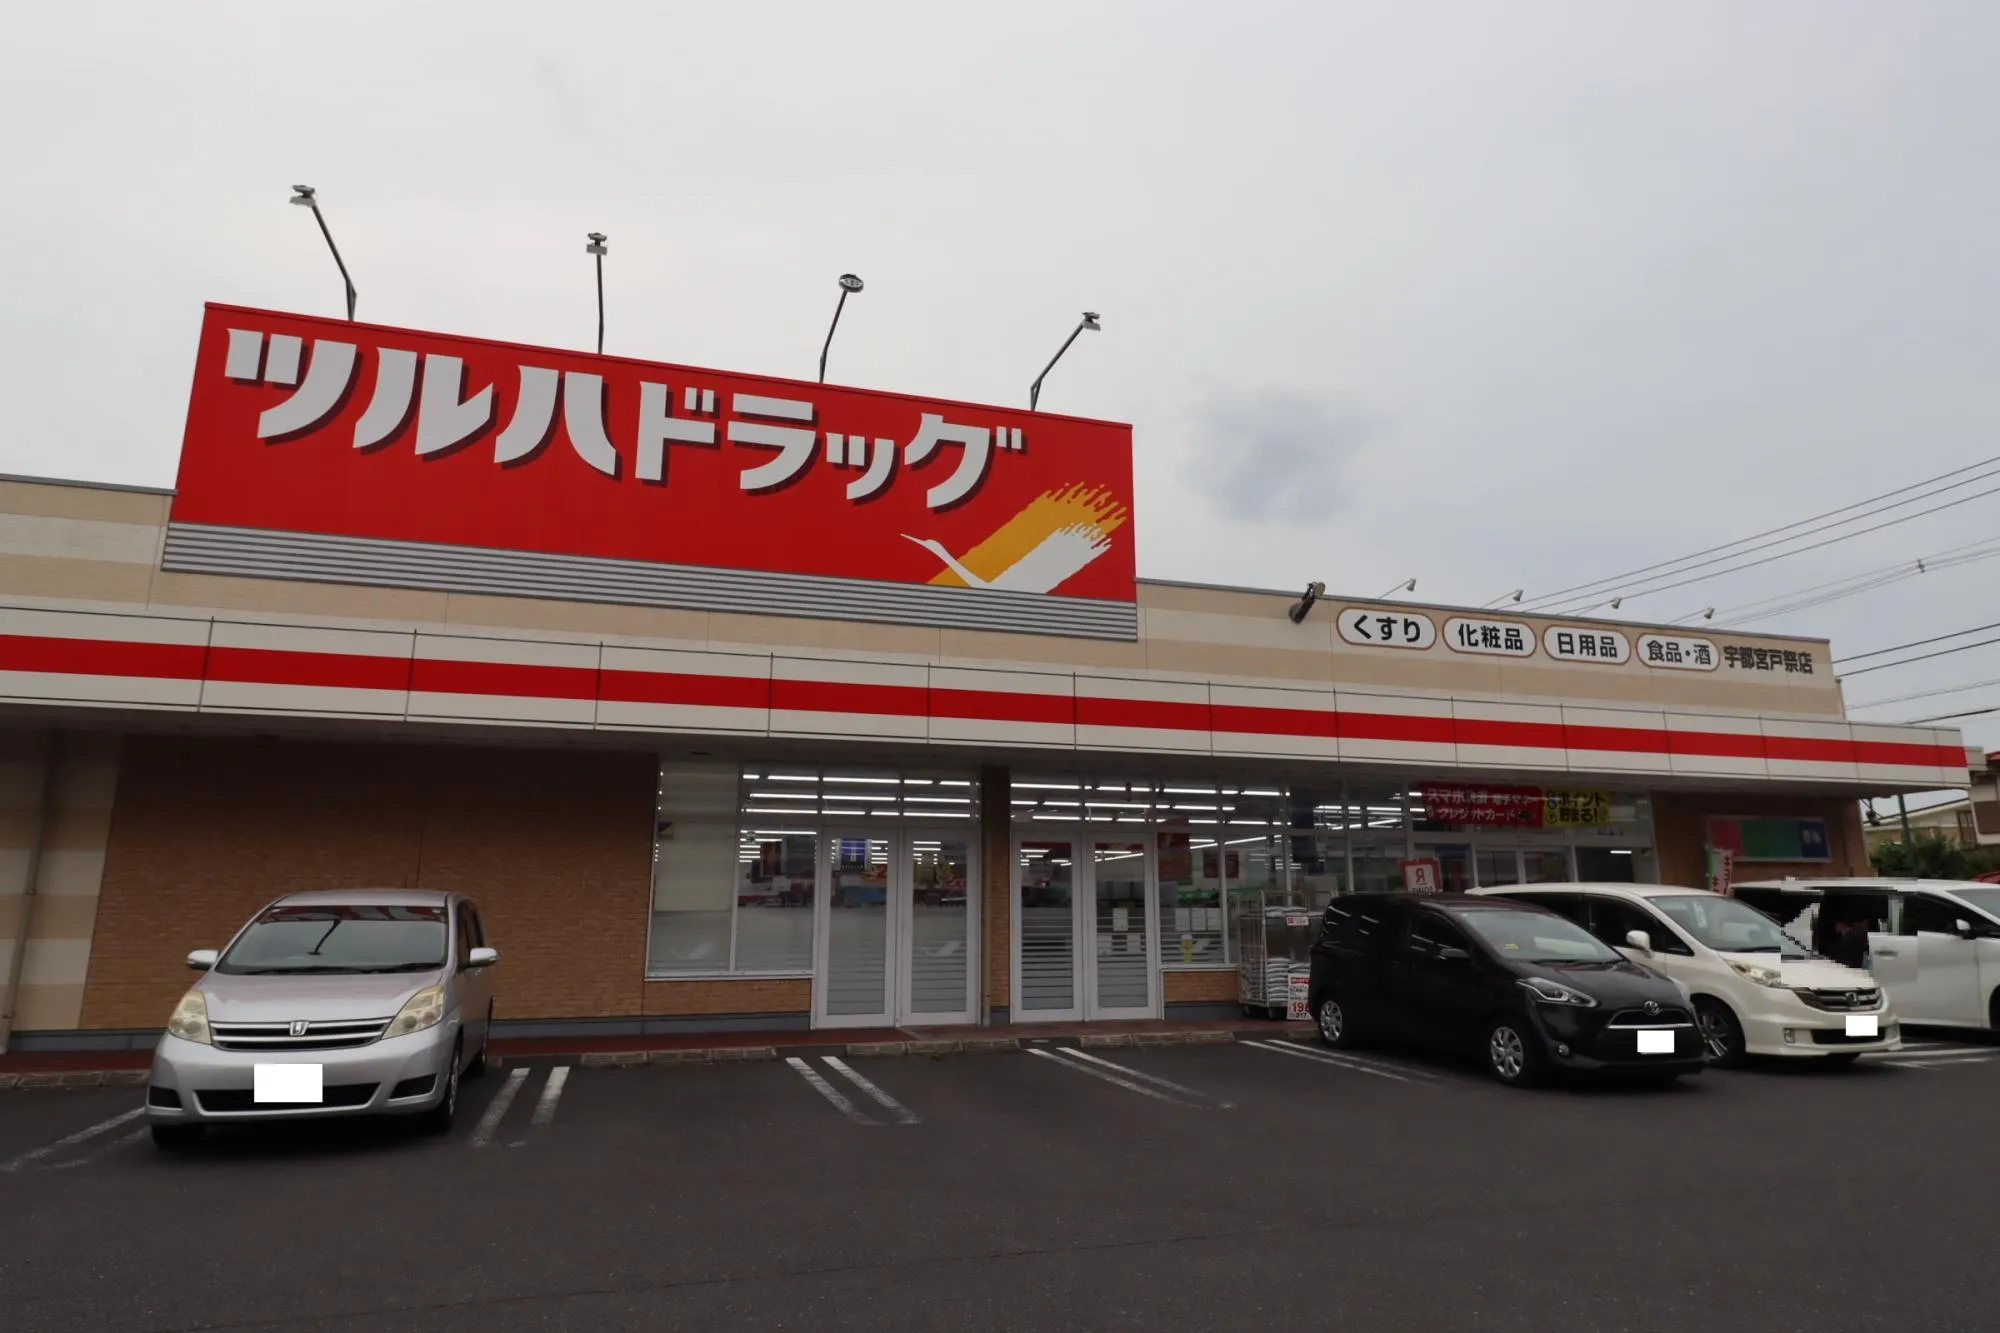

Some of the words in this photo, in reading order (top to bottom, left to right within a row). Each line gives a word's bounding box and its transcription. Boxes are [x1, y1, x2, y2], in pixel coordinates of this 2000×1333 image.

[226, 328, 1023, 508] ツルハドラッグ
[1353, 615, 1421, 643] くすり
[1458, 623, 1524, 651] 化粧品
[1557, 632, 1618, 658] 日用品
[1646, 639, 1711, 665] 食品・酒
[1723, 645, 1814, 674] 宇都宮戸祭店
